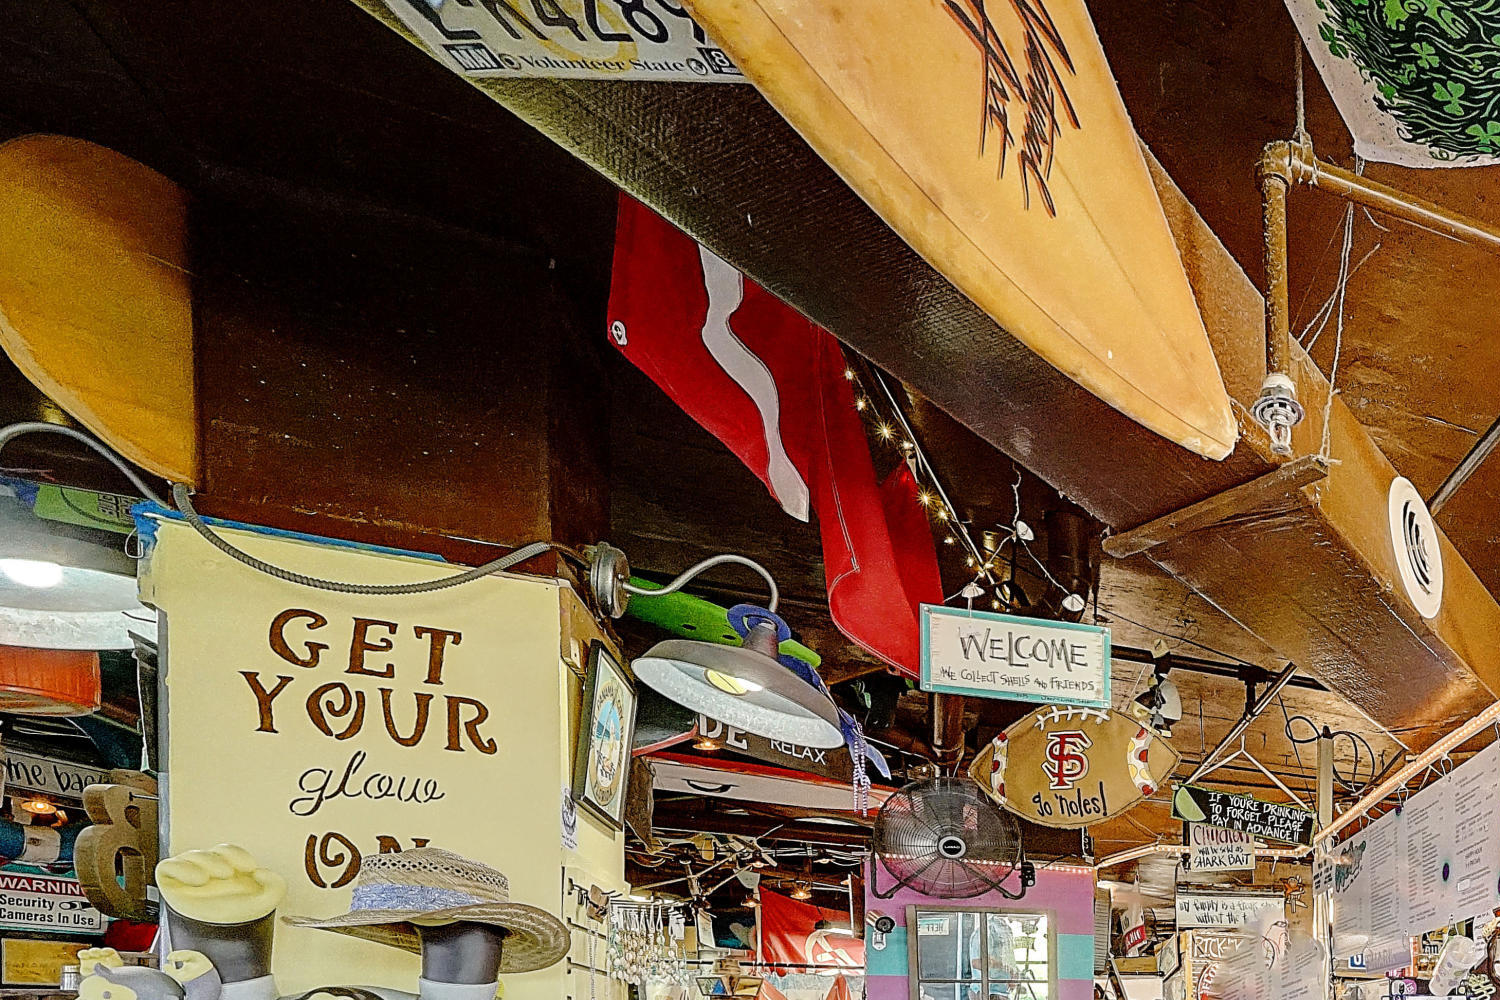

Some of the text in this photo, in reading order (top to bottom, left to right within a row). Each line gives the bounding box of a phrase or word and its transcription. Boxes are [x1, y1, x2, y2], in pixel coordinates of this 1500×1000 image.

[451, 47, 496, 70] MAY
[518, 54, 686, 72] Volunteer State
[268, 607, 462, 684] GET
[960, 628, 1088, 672] WELCOME
[941, 666, 957, 680] WE
[1000, 675, 1030, 686] SHELLS
[1034, 679, 1047, 689] AND
[1051, 677, 1094, 691] FRIENDS
[239, 669, 496, 755] YOUR
[770, 738, 826, 765] RELAX
[289, 749, 444, 816] glow
[1209, 792, 1221, 802] IF
[1263, 803, 1305, 820] DRINKING
[1194, 854, 1225, 868] SHARK
[0, 894, 54, 910] Security
[0, 908, 94, 926] Cameras In Use
